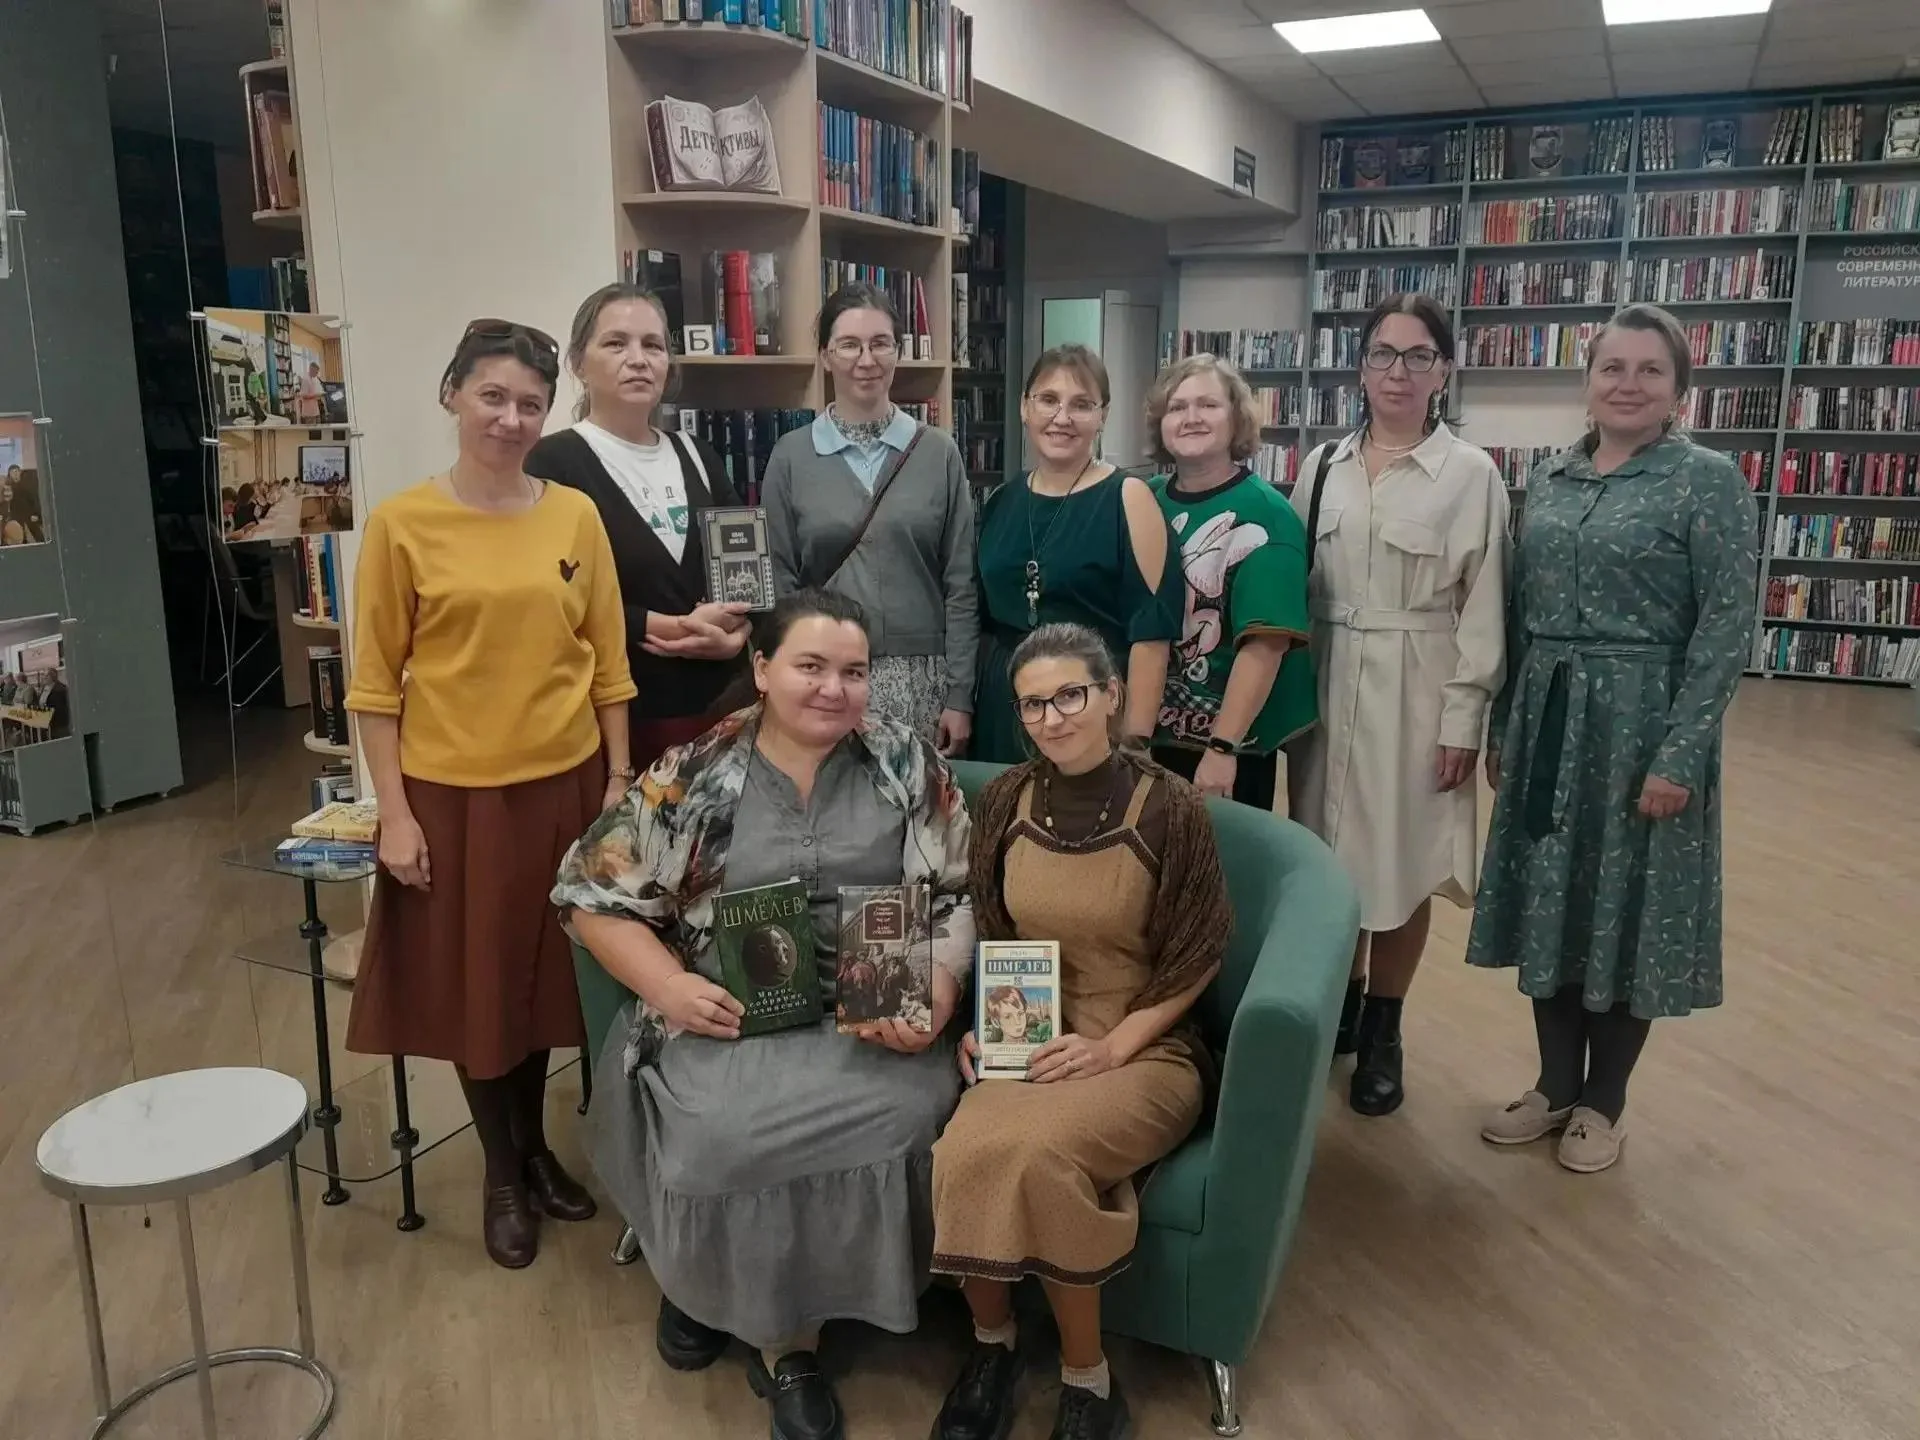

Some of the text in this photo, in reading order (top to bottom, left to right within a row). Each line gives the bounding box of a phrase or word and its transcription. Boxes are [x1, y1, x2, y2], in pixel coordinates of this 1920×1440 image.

[688, 329, 709, 351] Б
[722, 896, 803, 928] ШМЕЛЕВ
[988, 960, 1051, 972] ШМЕЛЕВ
